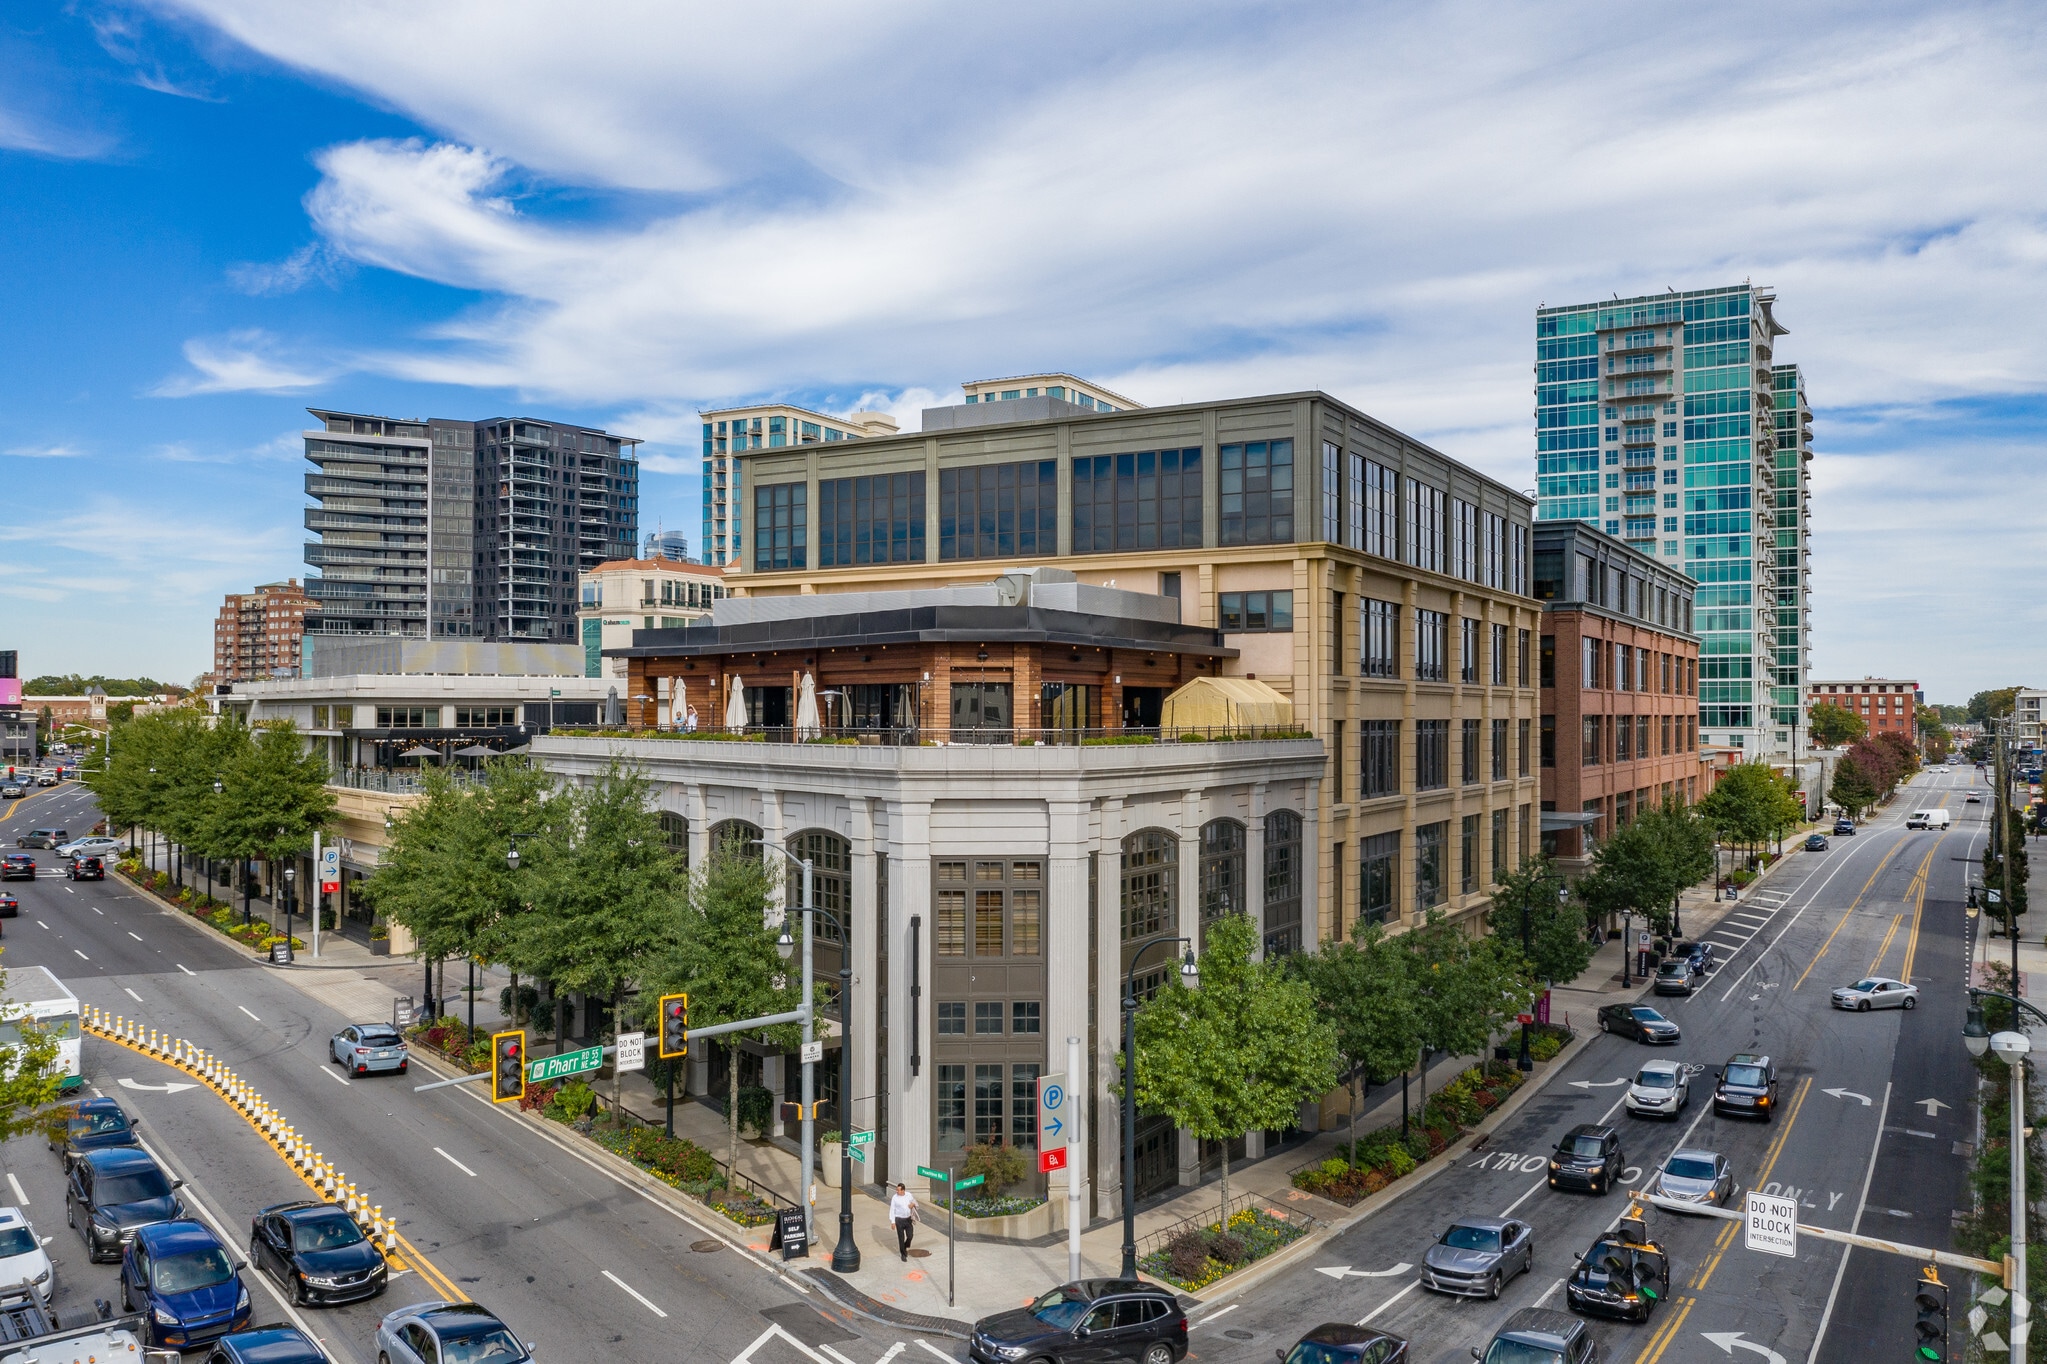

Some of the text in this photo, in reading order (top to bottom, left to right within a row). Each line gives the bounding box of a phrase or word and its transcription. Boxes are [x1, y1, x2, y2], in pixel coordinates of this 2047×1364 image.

[619, 1037, 642, 1048] DO NOT
[620, 1048, 641, 1058] BLOCK
[547, 1049, 599, 1076] Pharr RD 55
[581, 1060, 588, 1069] NE
[852, 1135, 867, 1144] Pharr
[1467, 1151, 1548, 1173] ONLY
[1751, 1200, 1793, 1218] DO NOT
[1752, 1217, 1791, 1235] BLOCK
[784, 1232, 805, 1240] PARKING
[1750, 1233, 1793, 1247] INTERSECTION
